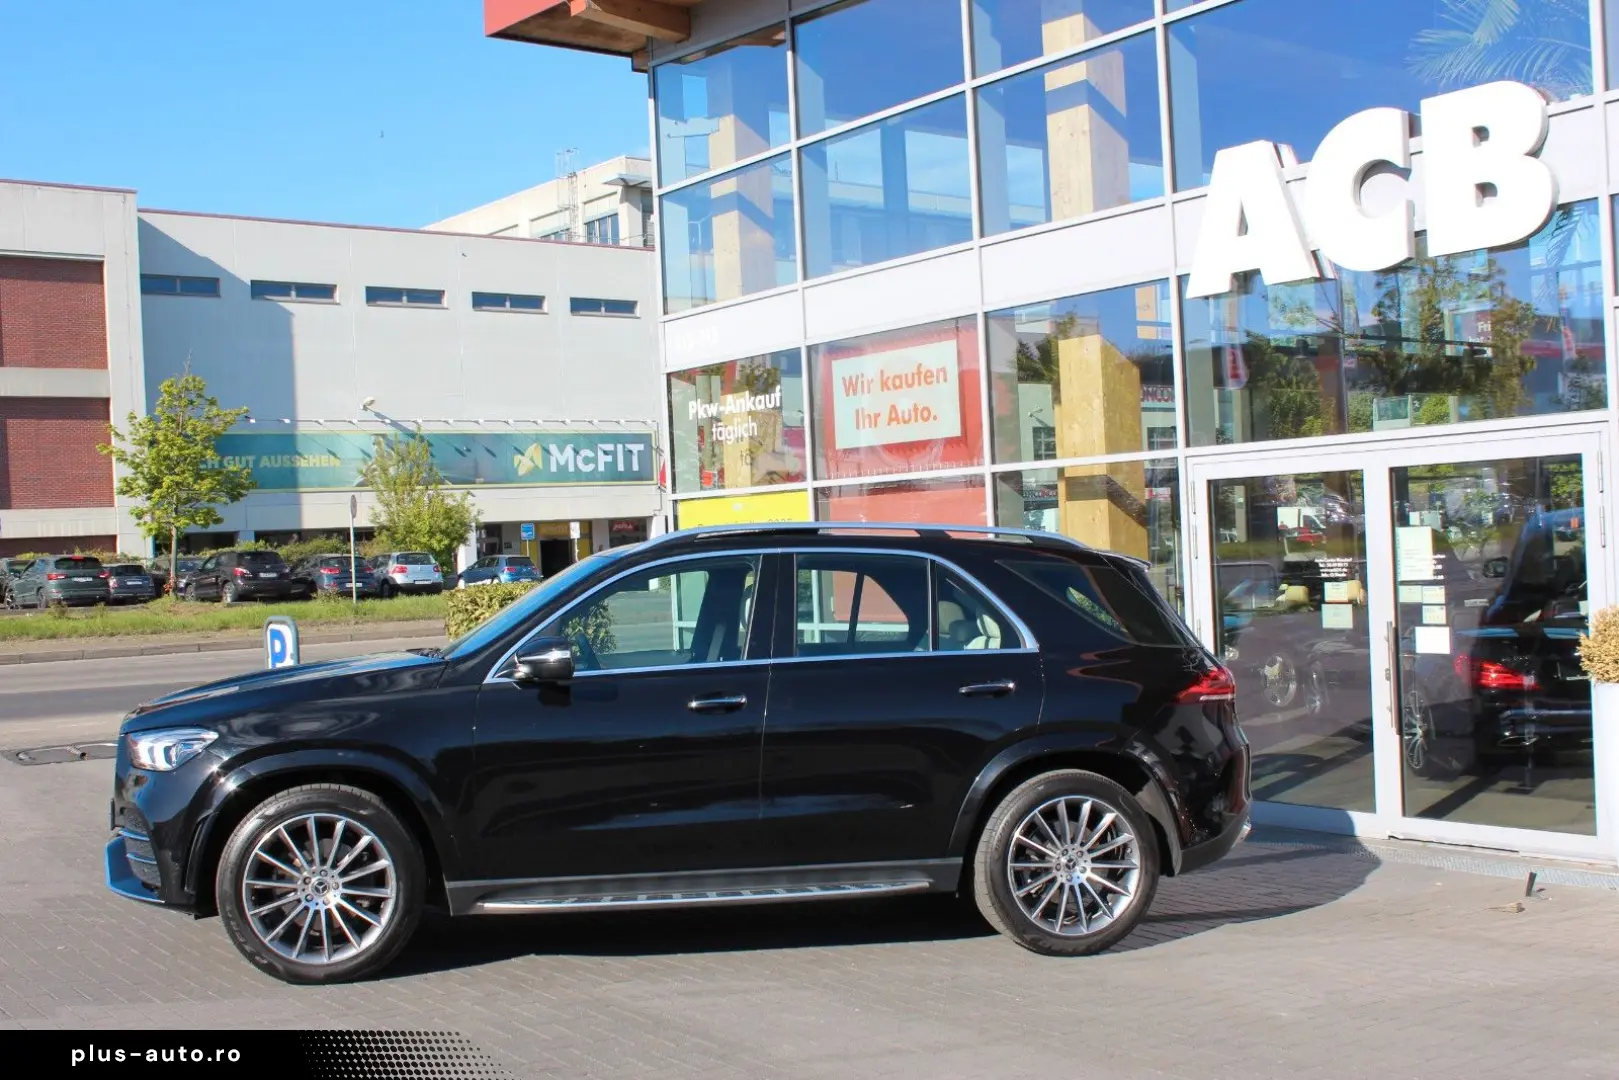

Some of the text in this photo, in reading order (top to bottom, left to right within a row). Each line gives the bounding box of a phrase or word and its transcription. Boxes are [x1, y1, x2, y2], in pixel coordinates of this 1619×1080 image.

[1186, 80, 1559, 299] ACB
[842, 363, 948, 397] Wir kaufen
[688, 384, 781, 420] Pkw-Ankauf
[855, 402, 938, 431] Ihr Auto.
[712, 415, 758, 445] täglich
[223, 455, 256, 469] GUT
[259, 453, 341, 469] AUSSEHEN
[548, 443, 645, 473] McFIT
